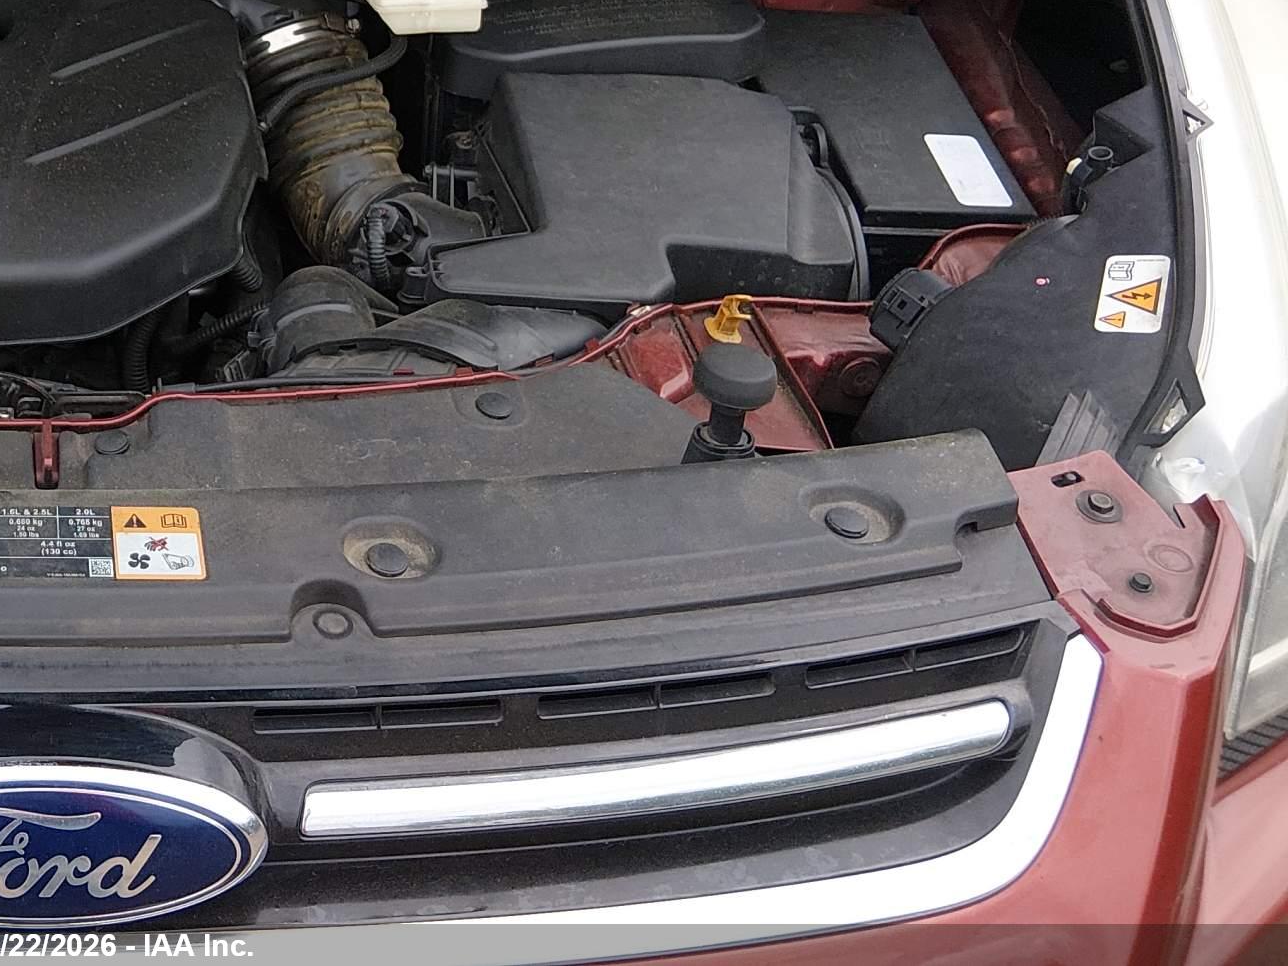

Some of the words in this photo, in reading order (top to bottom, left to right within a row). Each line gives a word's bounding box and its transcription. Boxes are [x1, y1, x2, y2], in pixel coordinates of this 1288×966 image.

[23, 508, 30, 516] &
[75, 508, 95, 516] 2.0L
[32, 518, 43, 527] kg
[92, 518, 103, 527] kg
